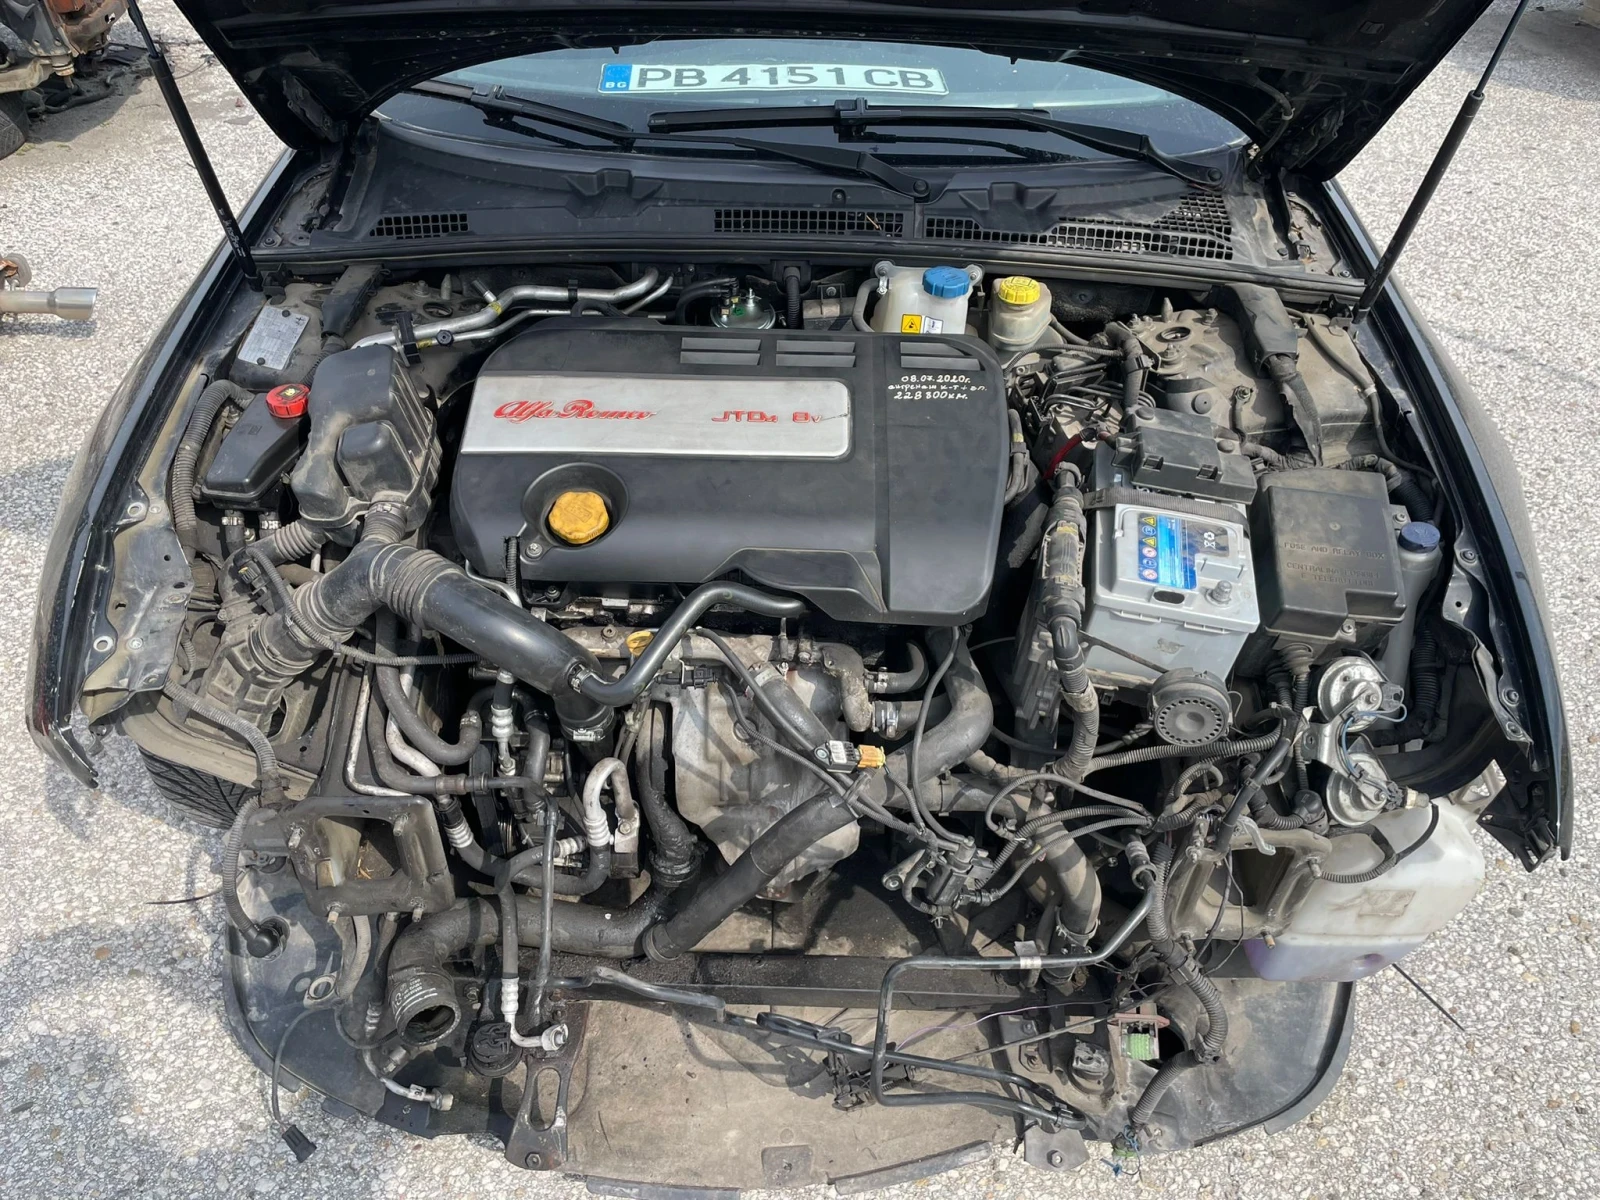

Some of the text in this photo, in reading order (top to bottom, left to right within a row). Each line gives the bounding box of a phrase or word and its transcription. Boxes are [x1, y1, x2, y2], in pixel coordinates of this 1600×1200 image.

[604, 66, 934, 89] BG PB 4151 CB
[893, 391, 922, 400] 228
[493, 399, 657, 424] Alfa Romeo
[1283, 541, 1385, 560] FUSE AND RELAY BOX
[1286, 561, 1340, 575] CENTRALINA
